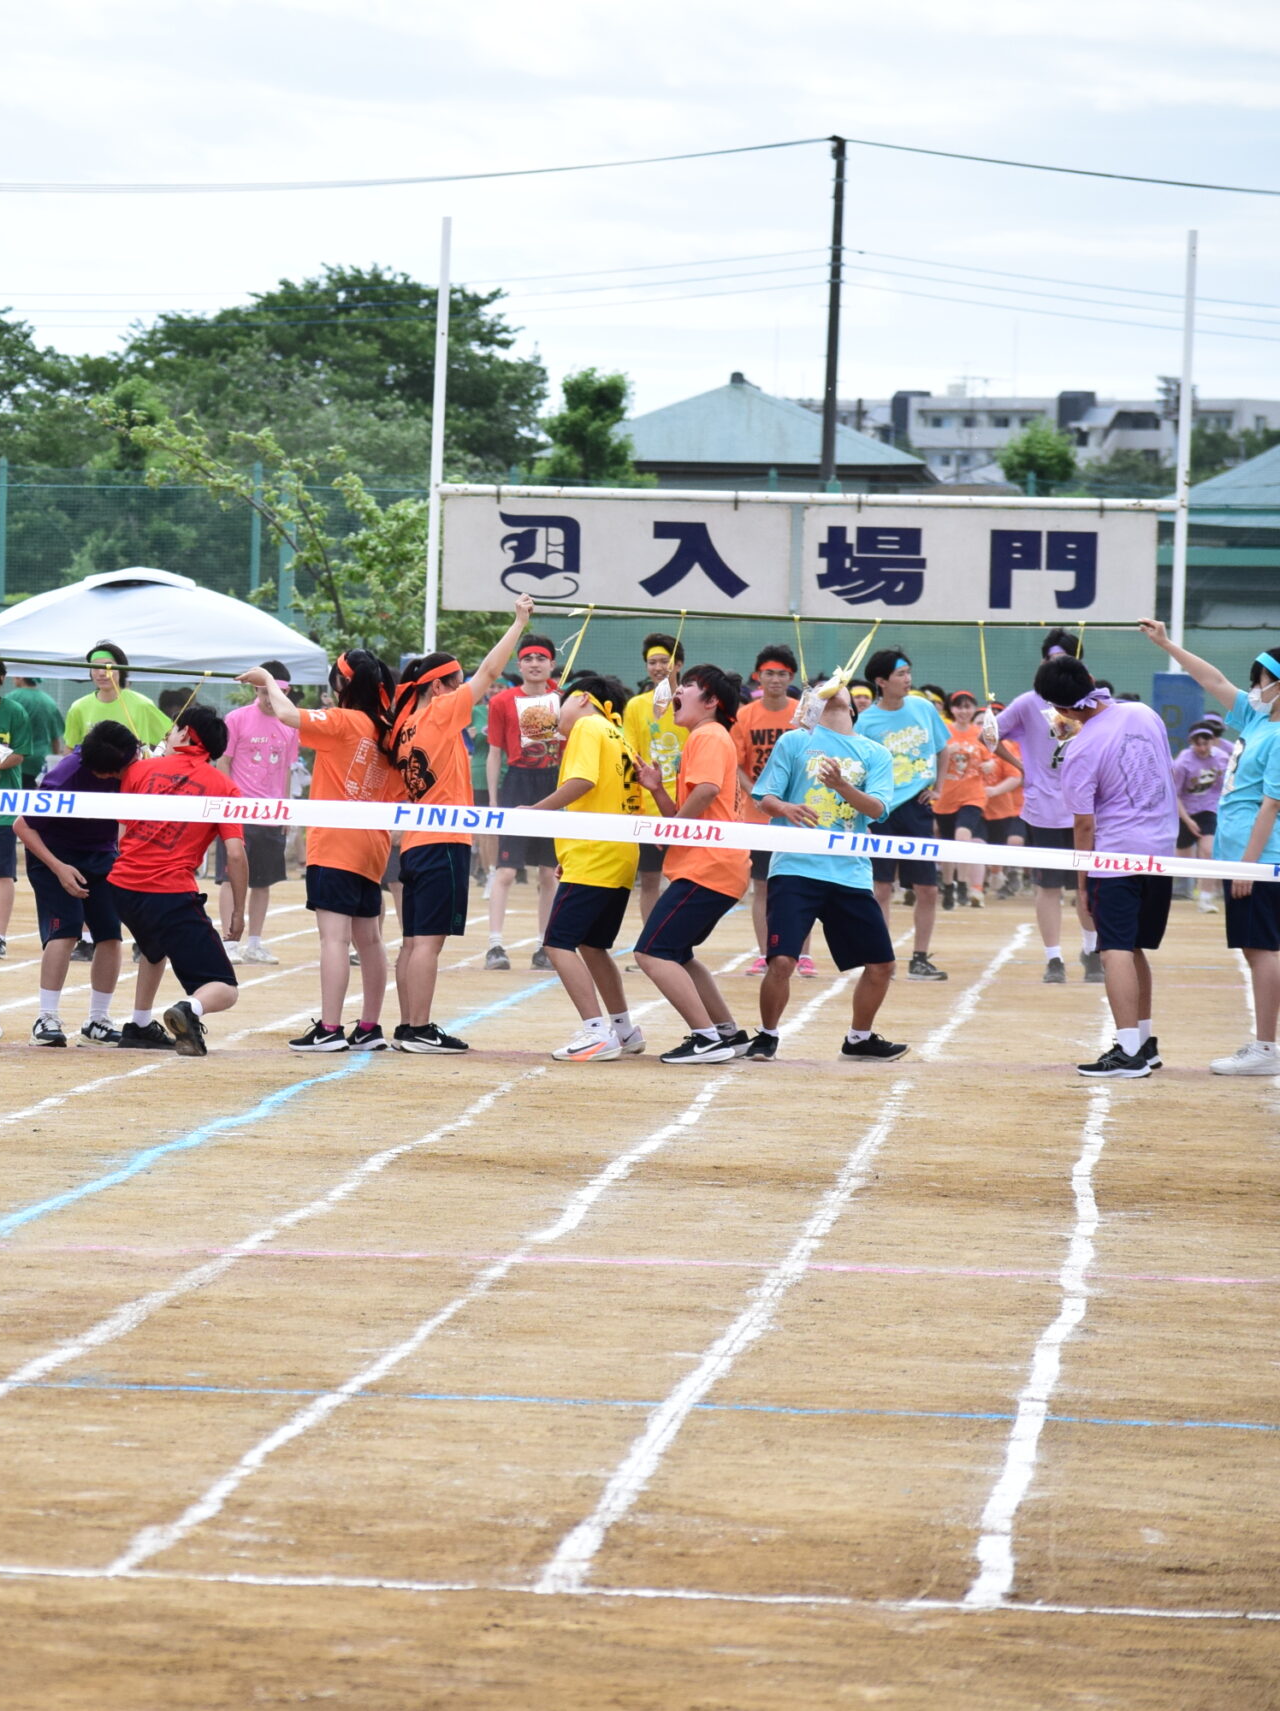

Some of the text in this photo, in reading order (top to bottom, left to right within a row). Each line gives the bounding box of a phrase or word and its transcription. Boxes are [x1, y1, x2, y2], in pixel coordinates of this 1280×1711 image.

[638, 521, 1098, 609] 入場門
[202, 798, 293, 820] Finish
